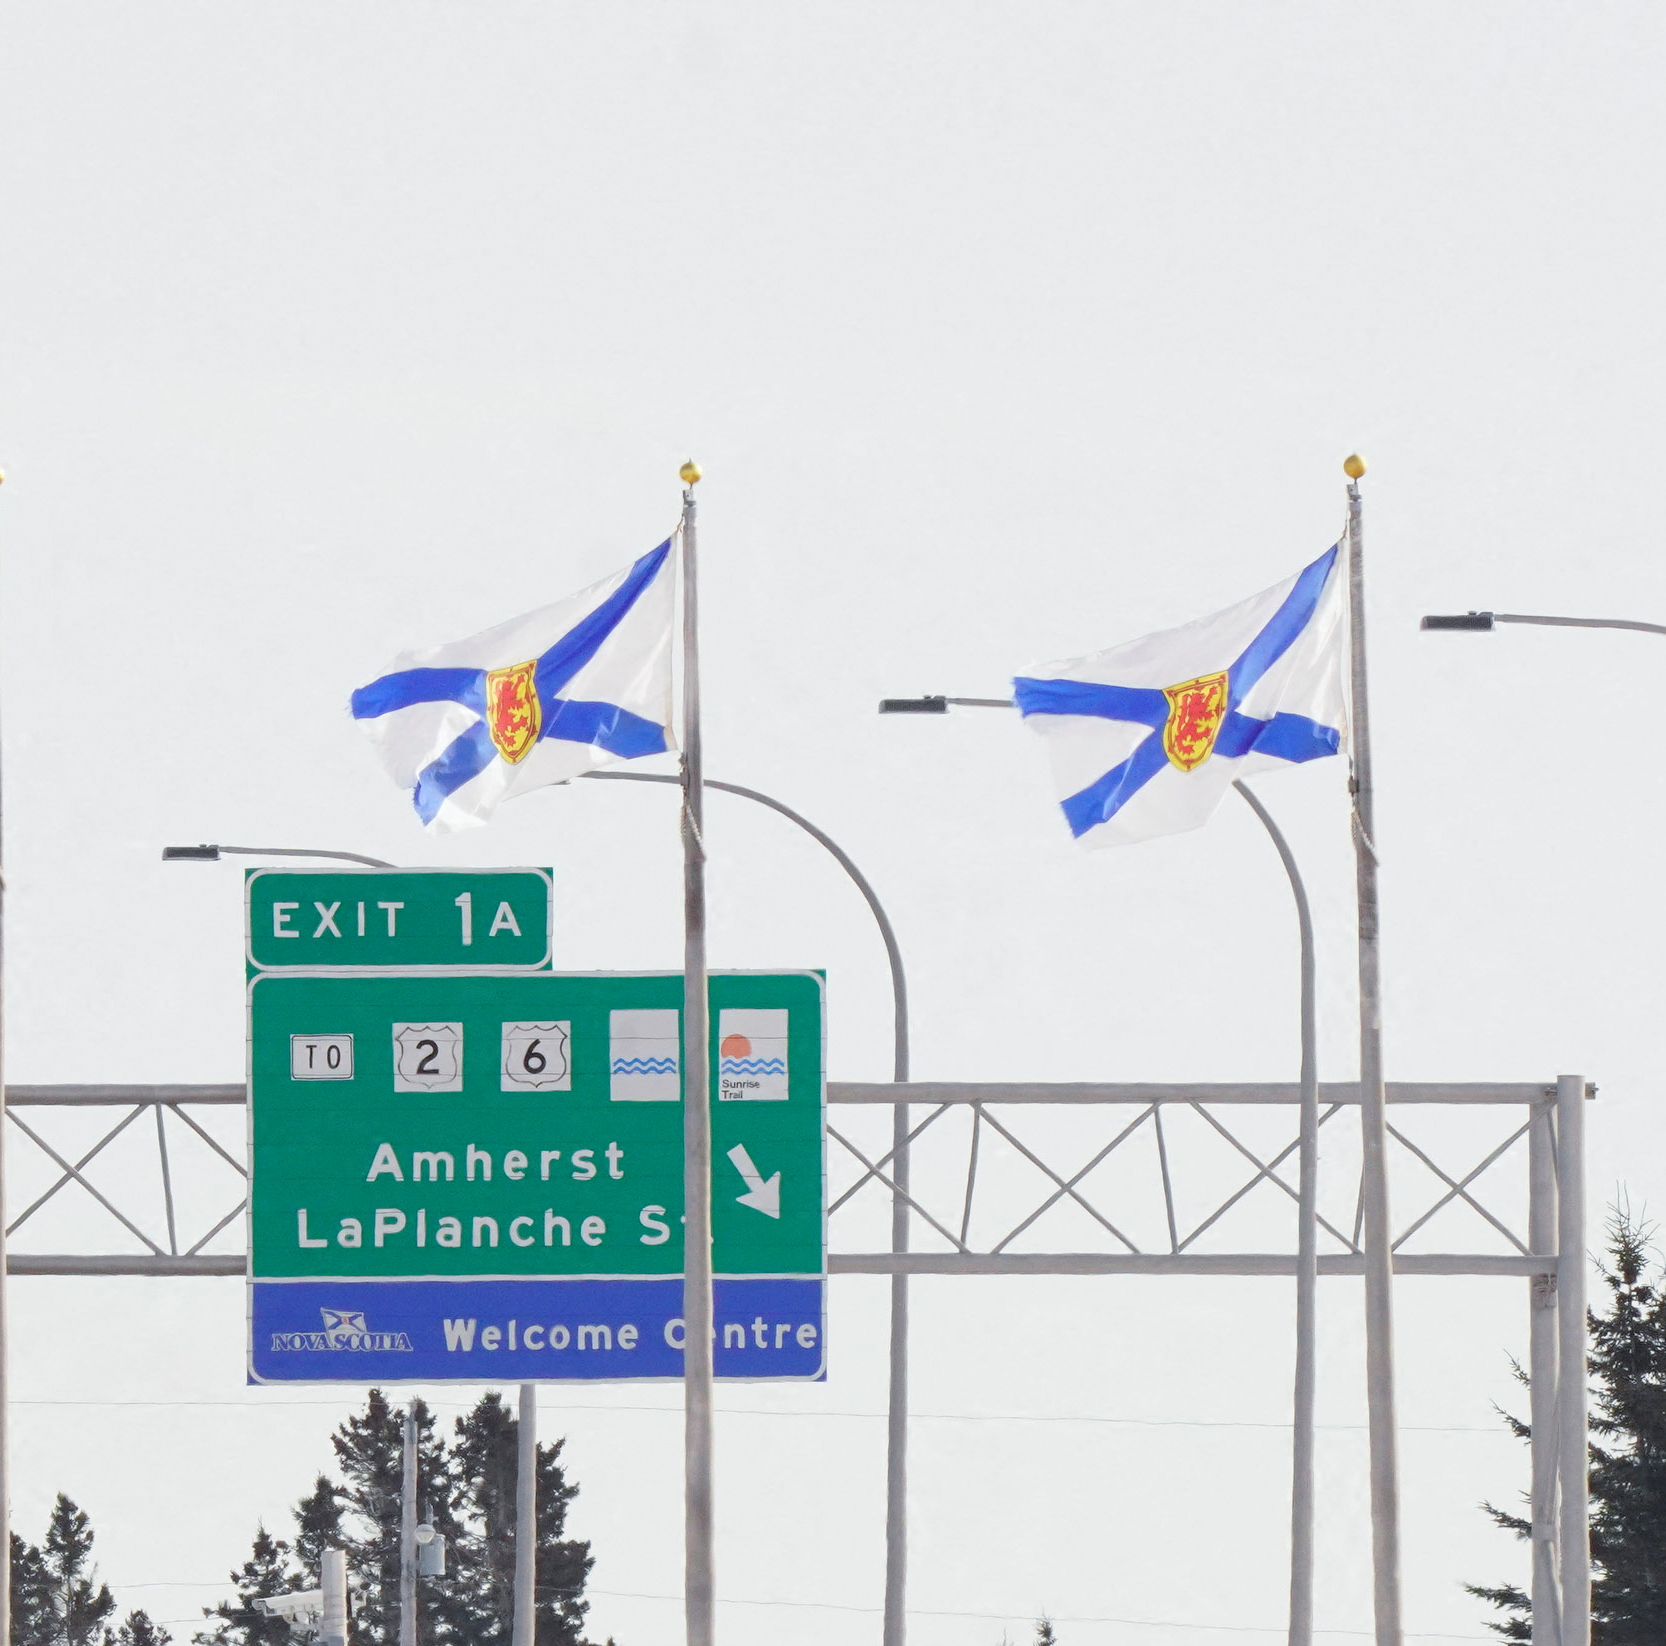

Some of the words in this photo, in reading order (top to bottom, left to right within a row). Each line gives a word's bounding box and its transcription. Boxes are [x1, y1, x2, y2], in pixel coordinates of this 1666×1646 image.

[272, 901, 404, 938] EXIT
[454, 892, 522, 945] 1A
[306, 1043, 342, 1070] TO
[415, 1039, 441, 1075] 2
[523, 1038, 548, 1075] 6
[721, 1090, 743, 1099] Trail
[722, 1079, 760, 1089] Sunrise
[365, 1142, 626, 1182] Amherst
[298, 1207, 608, 1249] LaPlanche
[271, 1332, 330, 1351] NOVA
[332, 1332, 414, 1351] SCOTIA
[442, 1317, 637, 1352] Welcome
[663, 1316, 817, 1349] Cntre
